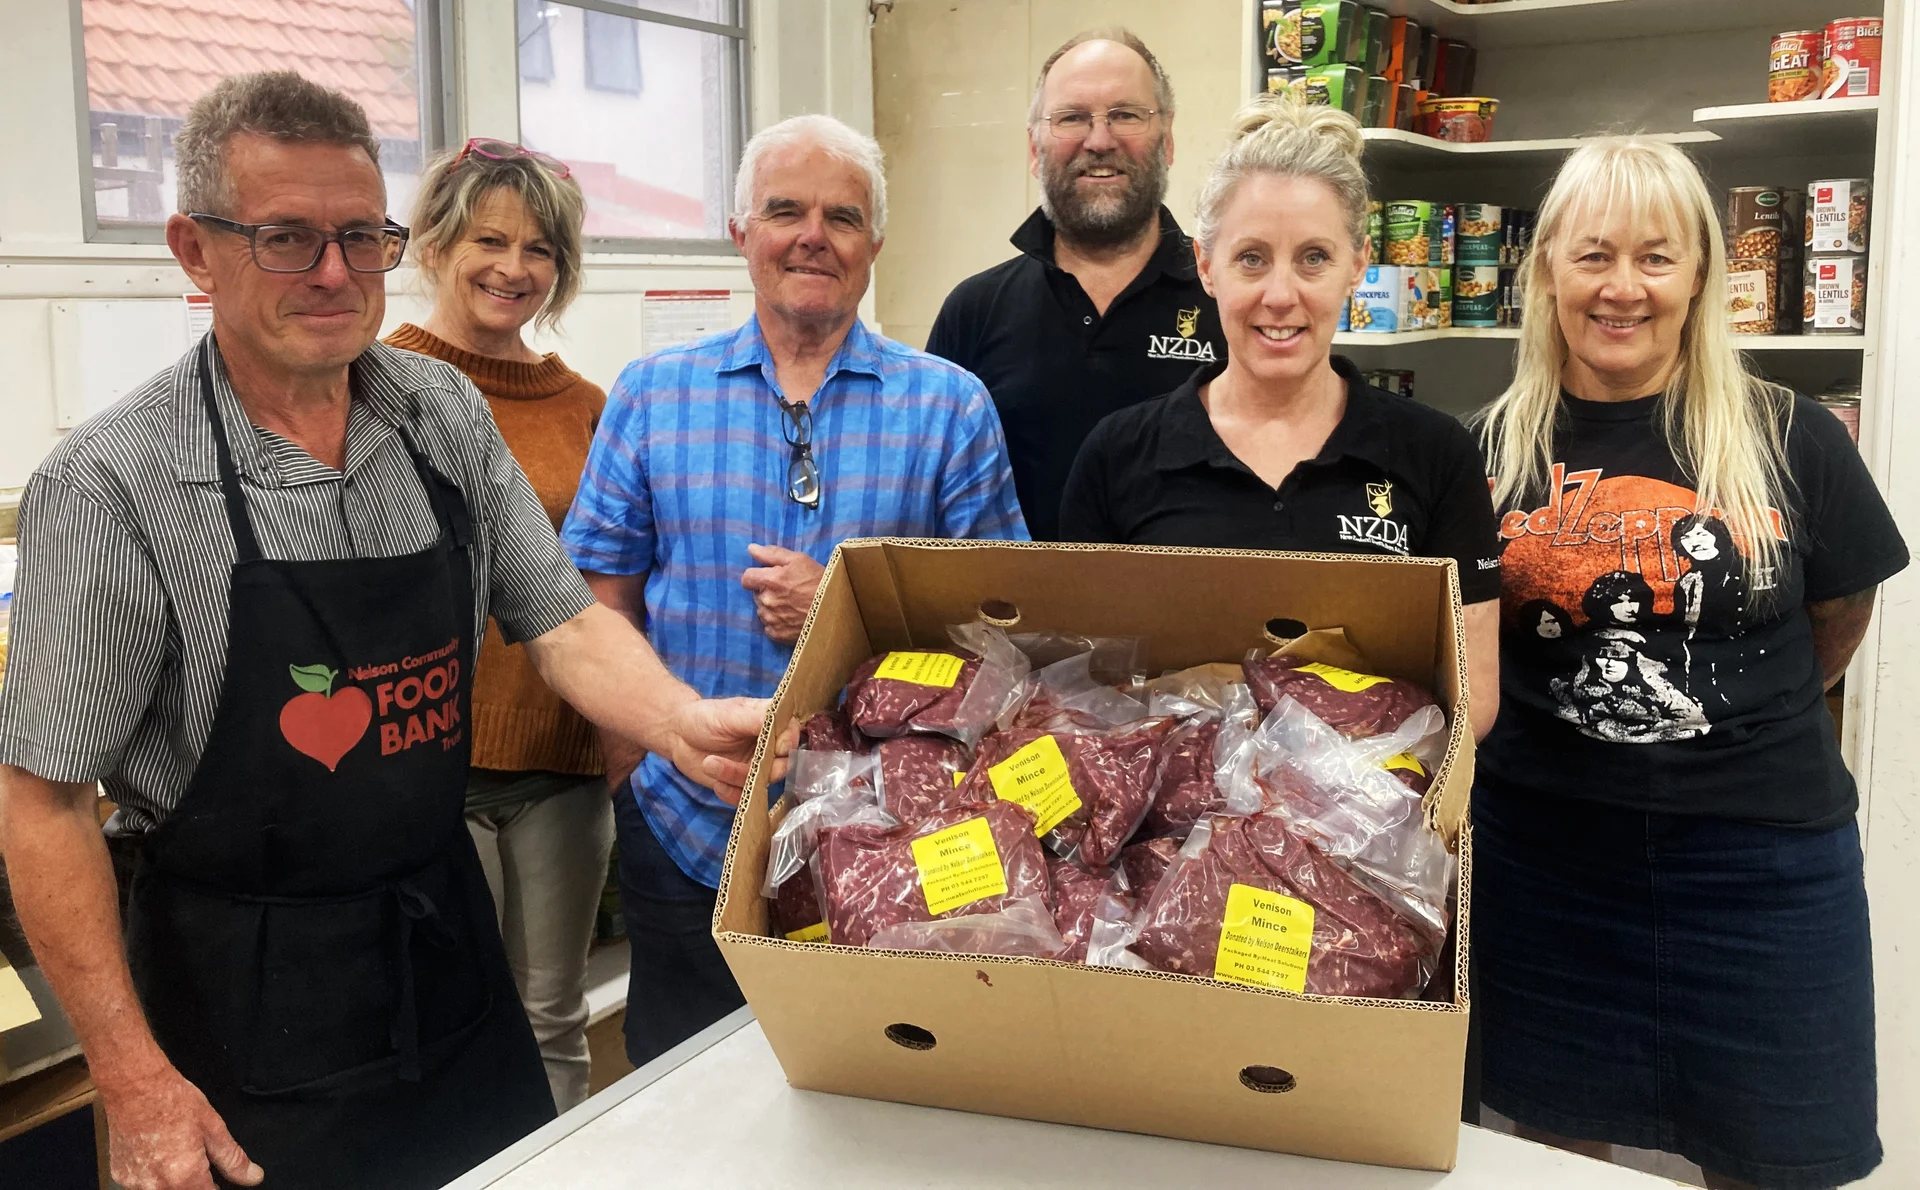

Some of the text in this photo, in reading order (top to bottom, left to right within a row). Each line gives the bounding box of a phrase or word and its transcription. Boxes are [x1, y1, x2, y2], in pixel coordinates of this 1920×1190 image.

[1754, 211, 1780, 221] Lentils
[1816, 212, 1846, 222] LENTILS
[1355, 291, 1390, 299] CHICKPEAS
[1729, 282, 1755, 294] ENTILS
[1818, 290, 1849, 299] LENTILS
[1147, 335, 1217, 360] NZDA
[1337, 515, 1409, 550] NZDA
[348, 663, 398, 681] Nelson
[376, 658, 460, 717] FOOD
[380, 692, 461, 756] BANK
[1009, 752, 1040, 772] Venison
[1016, 767, 1046, 786] Mince
[934, 830, 969, 846] Venison
[939, 843, 971, 858] Mince
[1253, 898, 1292, 916] Venison
[1251, 916, 1288, 933] Mince
[1223, 947, 1252, 958] Packaged
[1225, 931, 1308, 959] Donated by Nelson Deerstalkers
[1234, 962, 1289, 980] PH 03 544 7297
